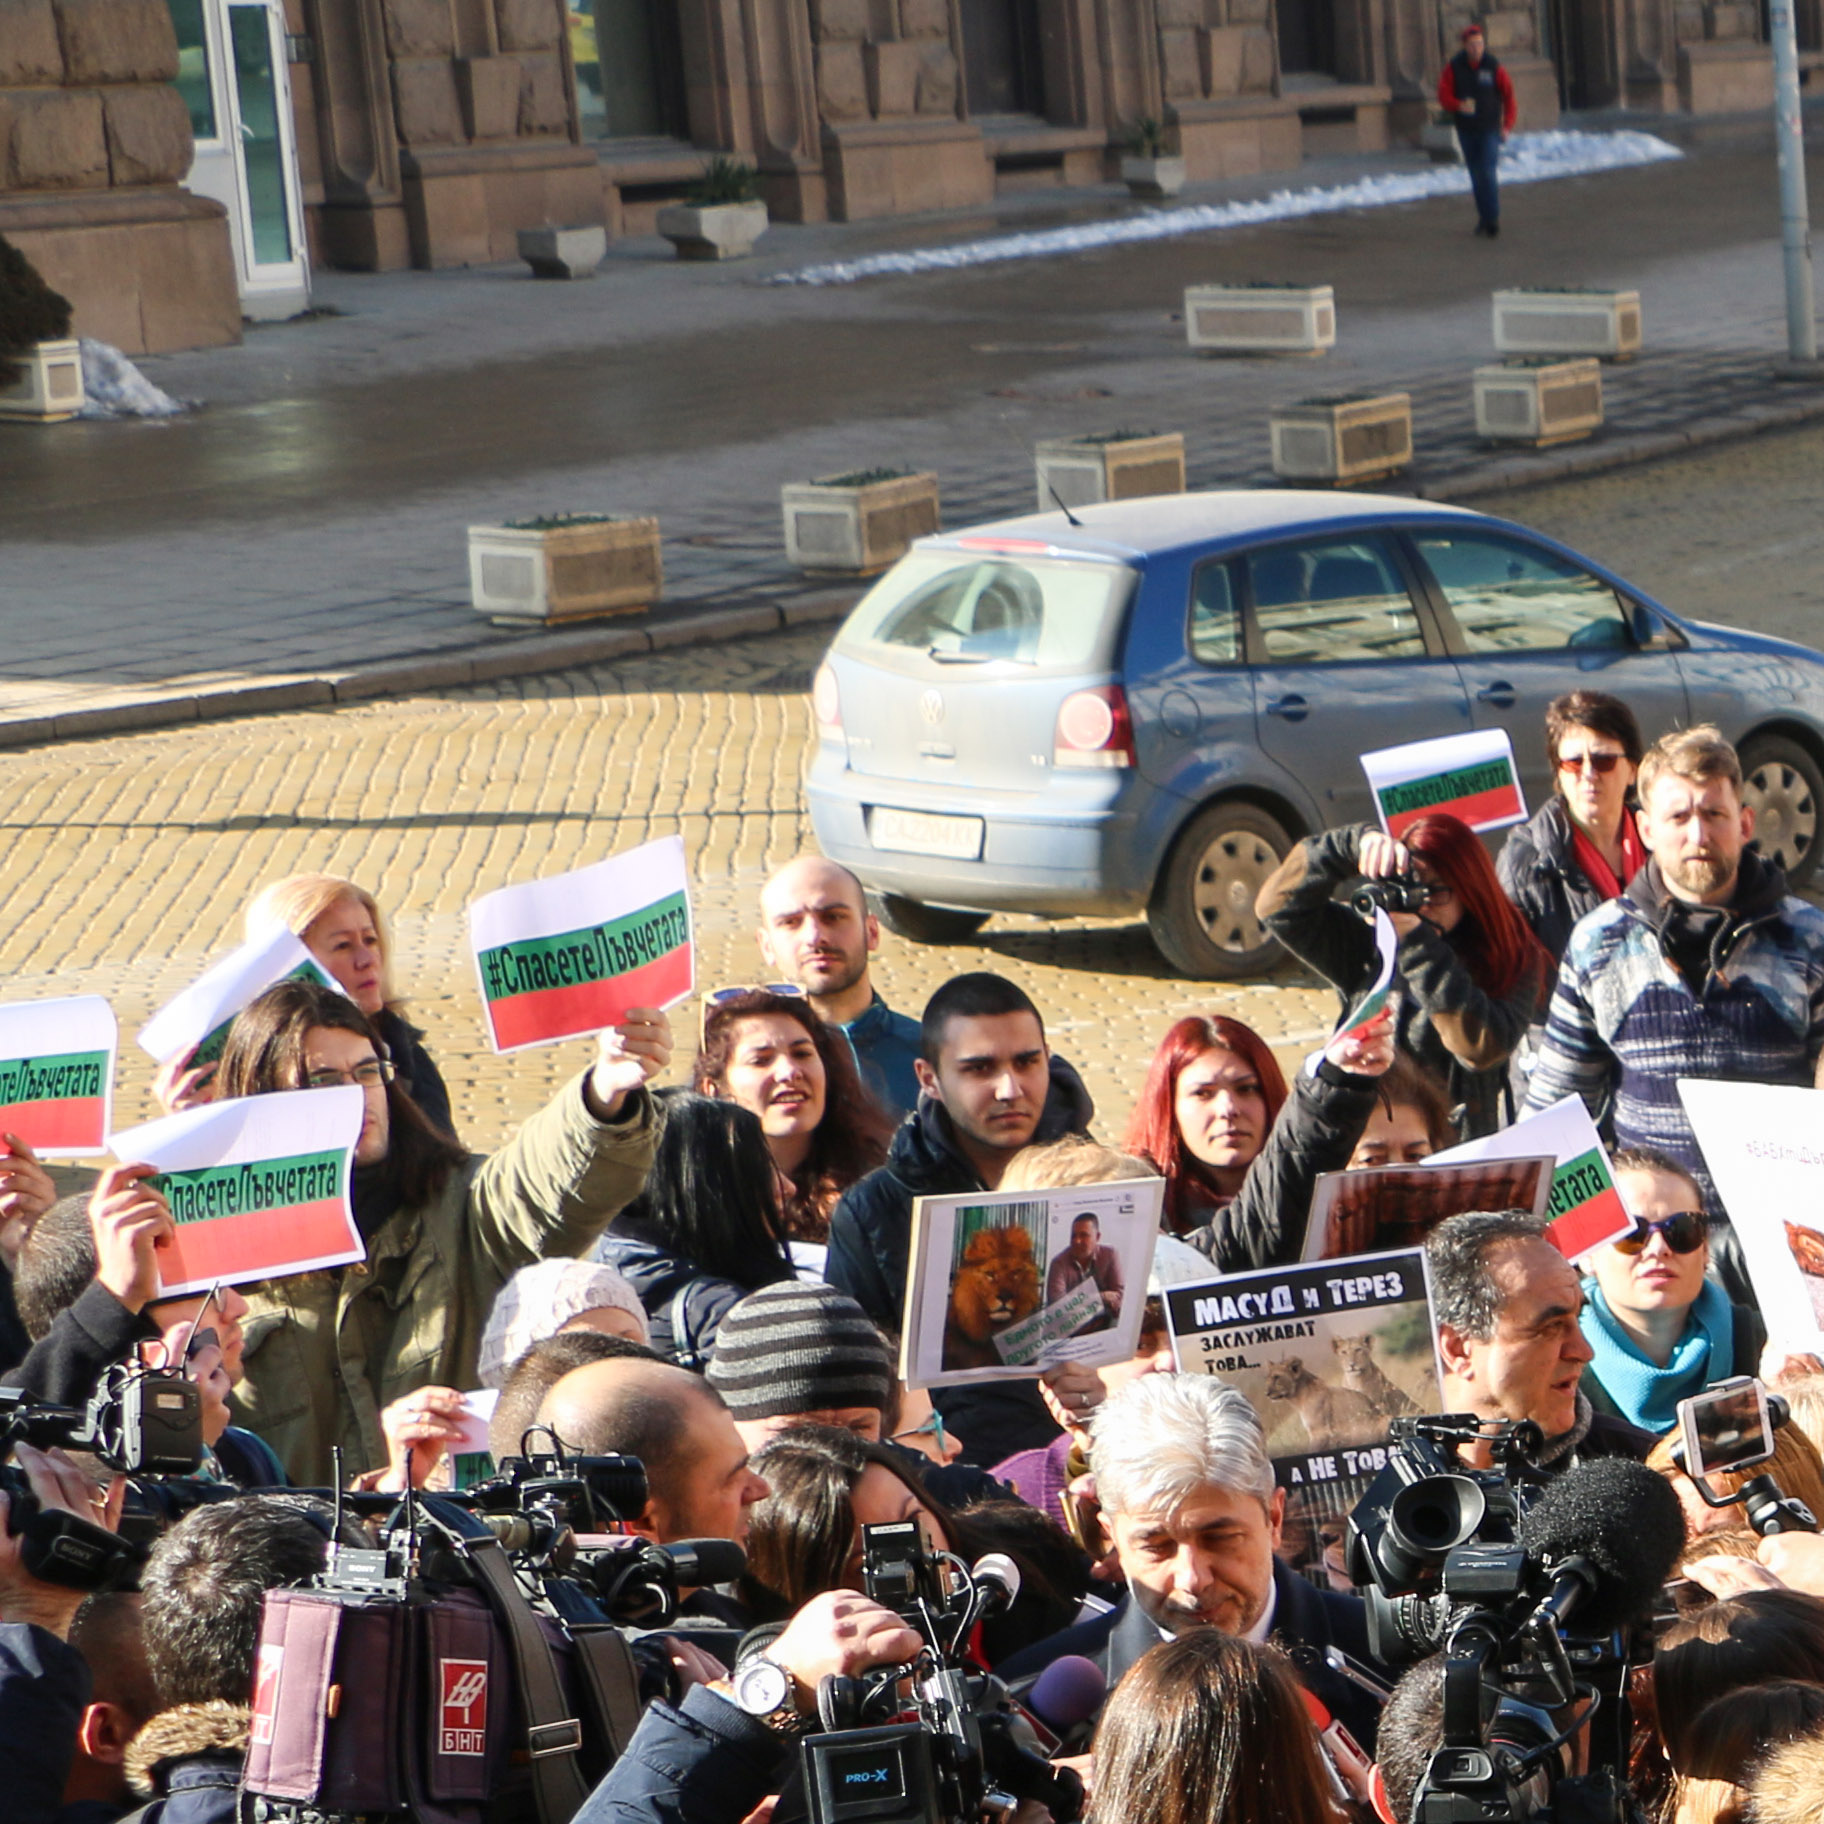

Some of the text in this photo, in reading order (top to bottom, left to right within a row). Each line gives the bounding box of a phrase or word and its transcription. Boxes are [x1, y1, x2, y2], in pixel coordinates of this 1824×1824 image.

[487, 905, 688, 999] #СпасетеЛъвчетата
[152, 1159, 338, 1223] СпасетеЛъвчетата
[1193, 1284, 1296, 1327] МАСУД
[1325, 1271, 1405, 1307] ТЕРЕЗ
[1201, 1319, 1316, 1353] ЗАСЛУЖАВАТ
[1204, 1358, 1262, 1376] ТОВА...
[1306, 1455, 1339, 1482] НЕ
[445, 1732, 483, 1751] БНТ
[845, 1768, 889, 1783] PRO-X
